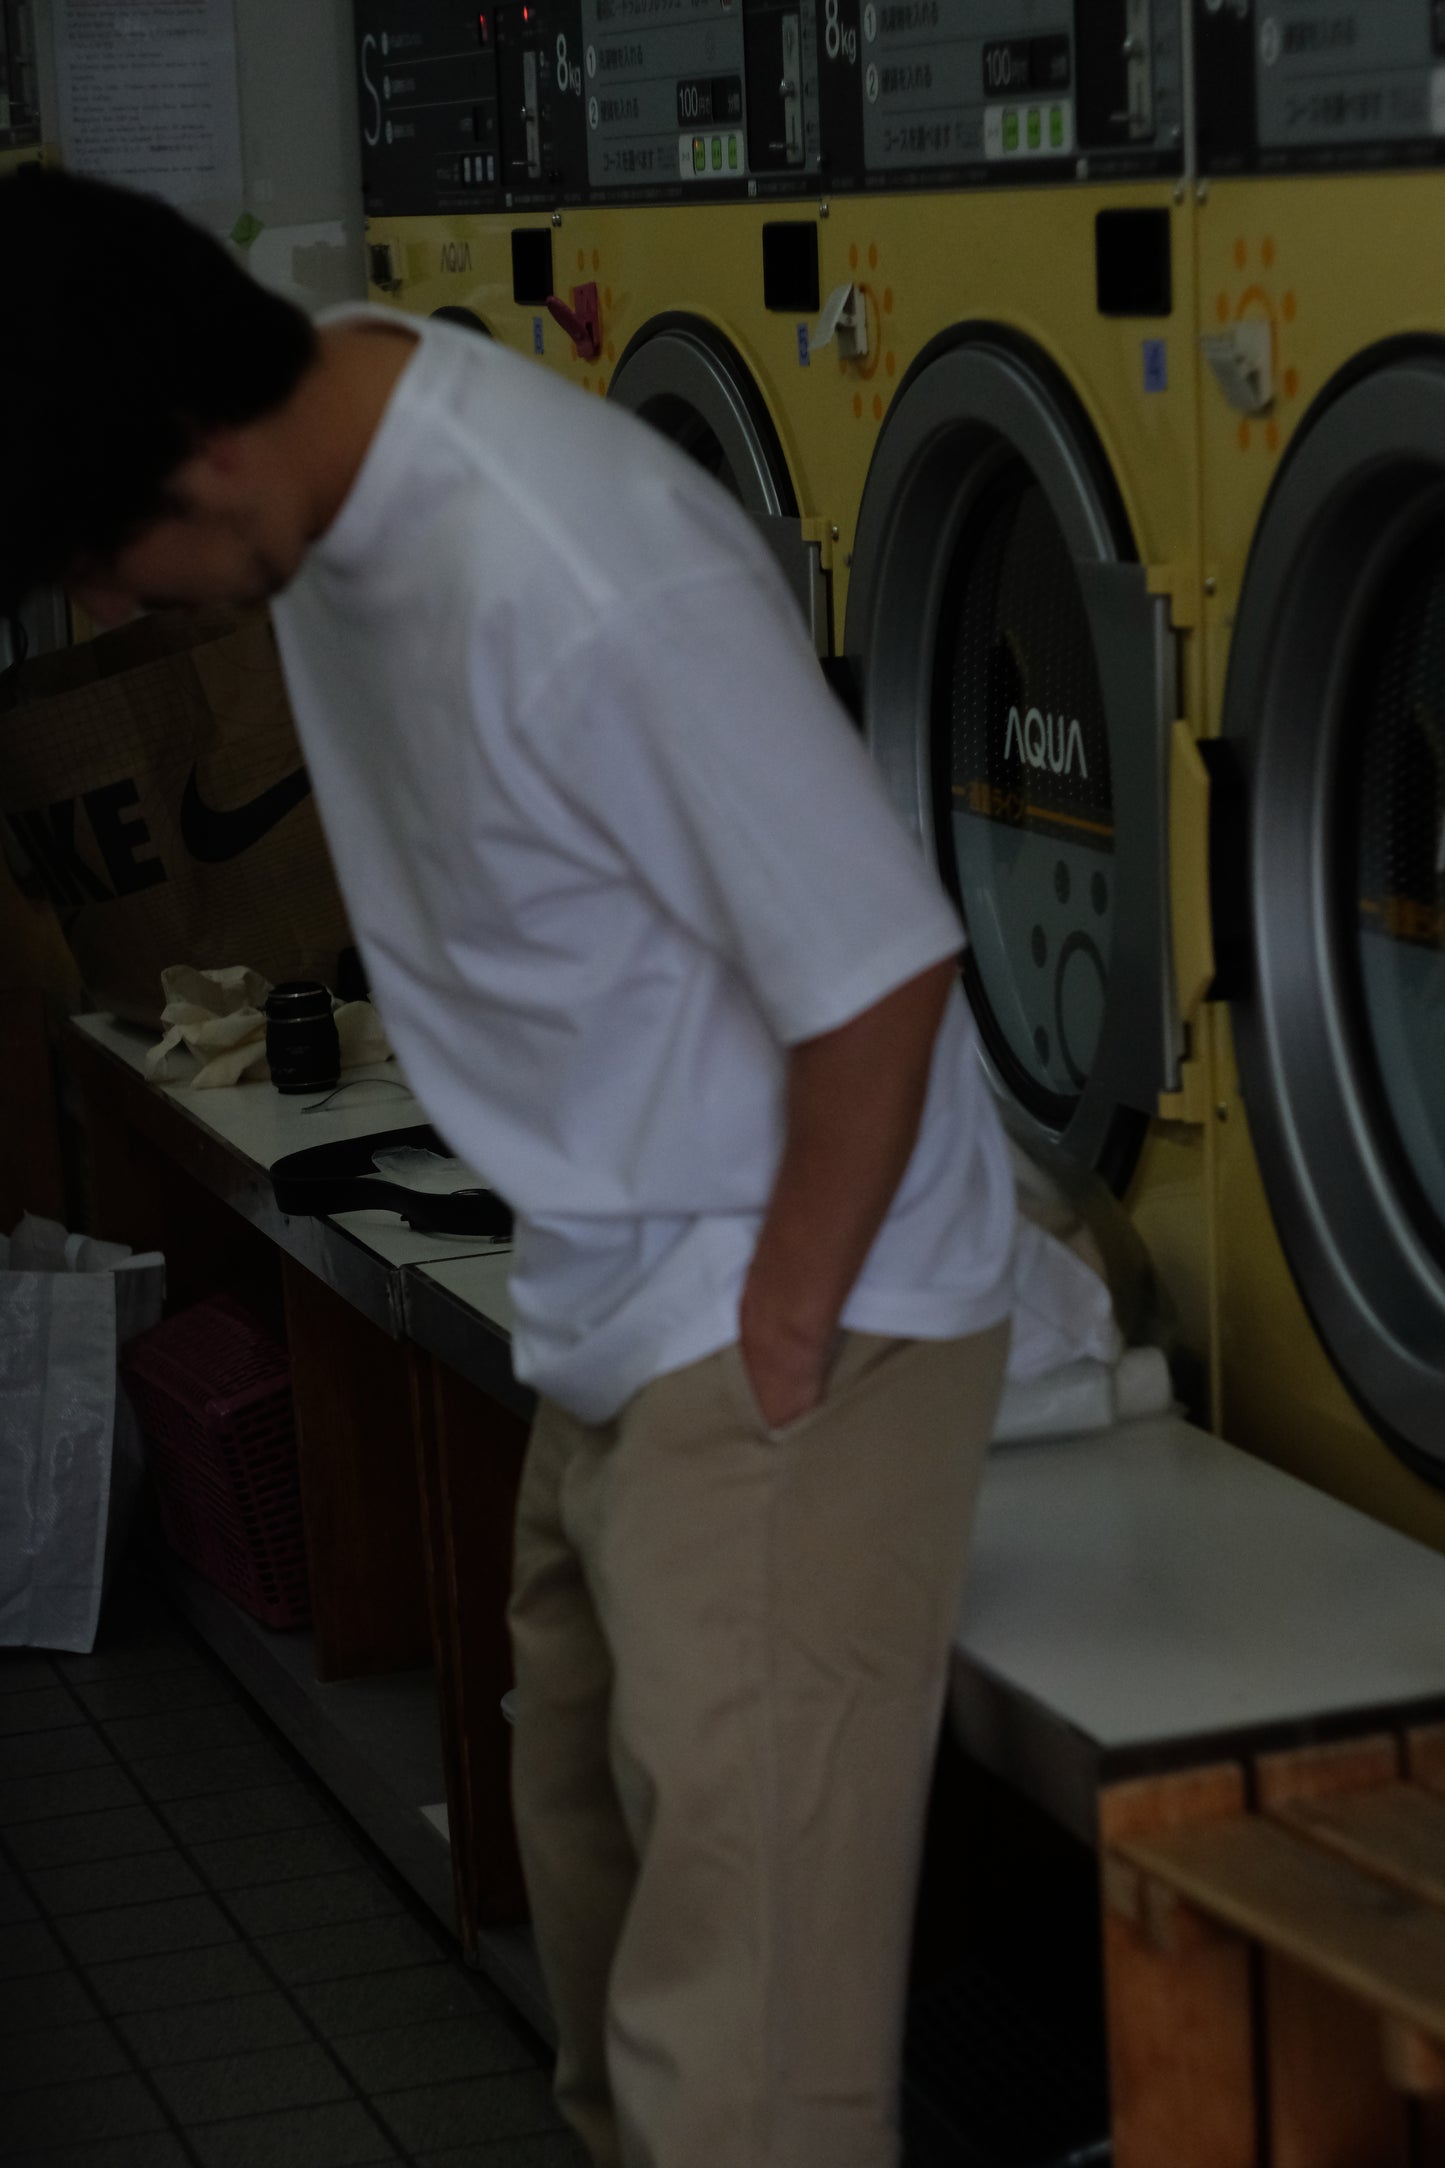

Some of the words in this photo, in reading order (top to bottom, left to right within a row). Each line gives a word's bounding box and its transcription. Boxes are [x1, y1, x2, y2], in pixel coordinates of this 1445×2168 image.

[825, 0, 857, 64] 8kg
[556, 33, 582, 96] 8kg
[440, 241, 472, 273] AQUA
[1004, 705, 1088, 779] AQUA
